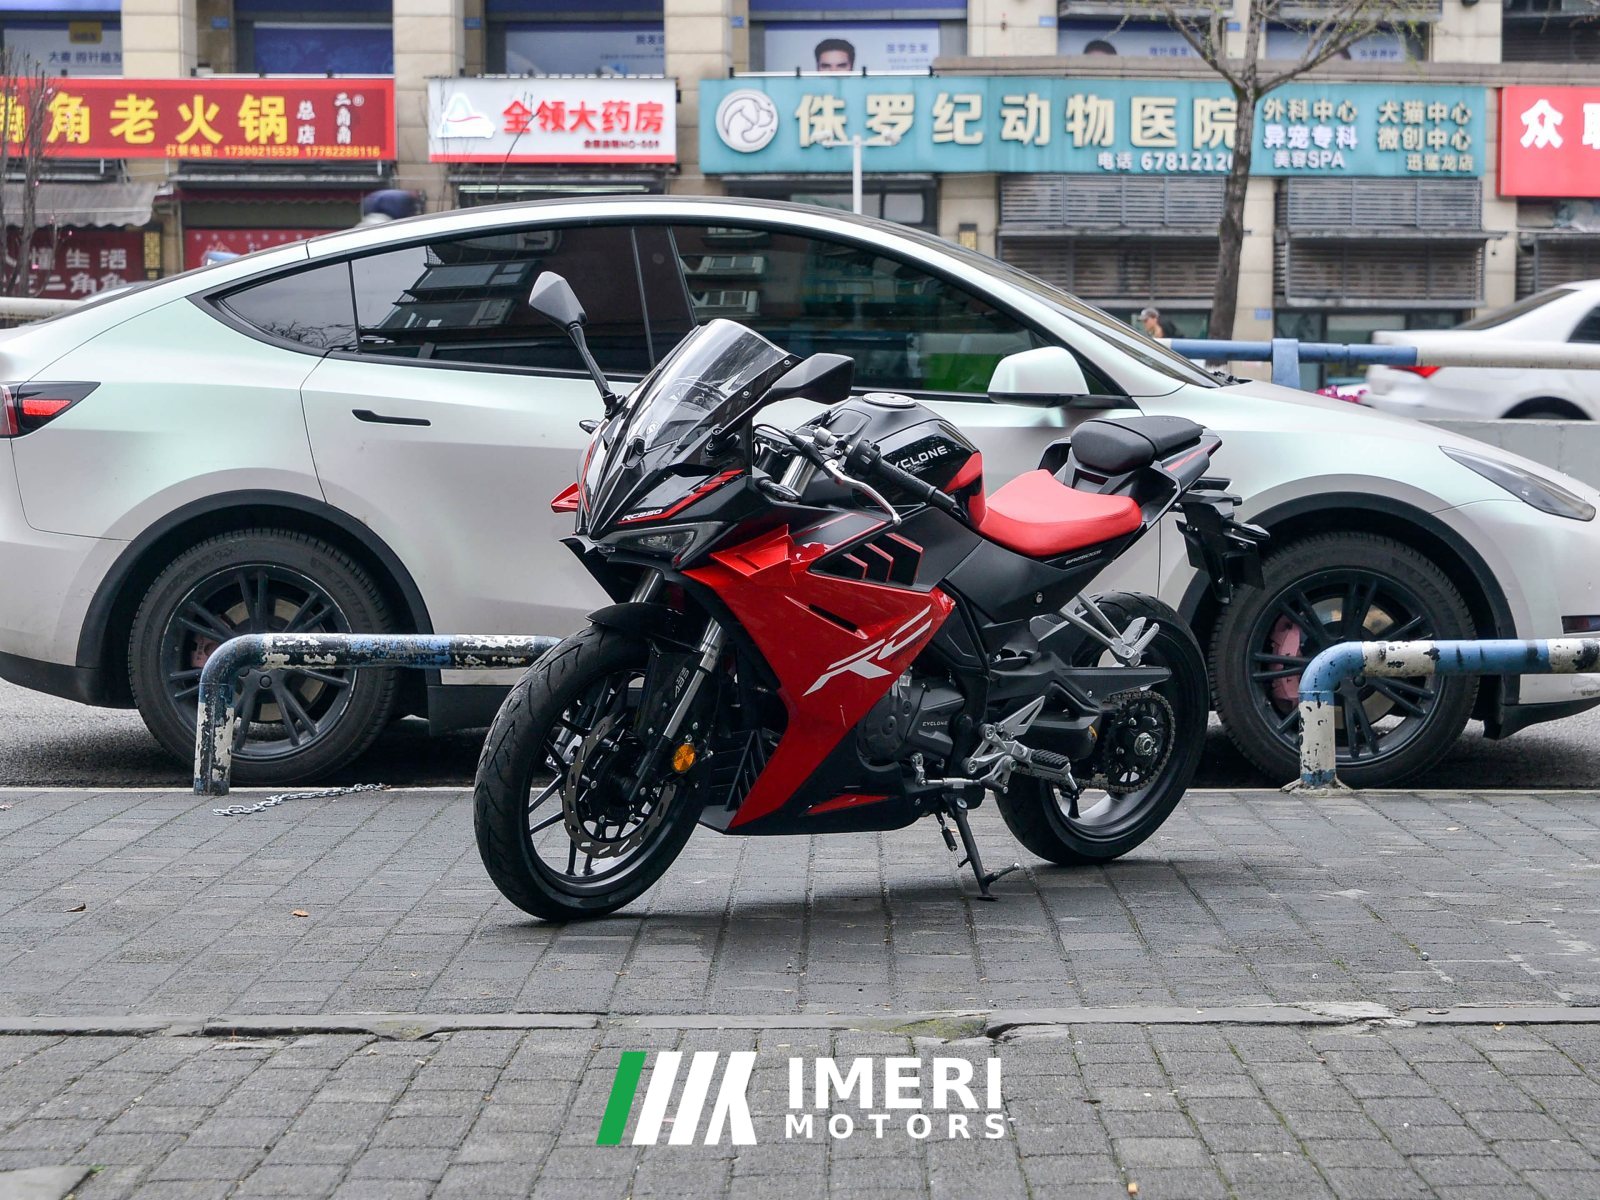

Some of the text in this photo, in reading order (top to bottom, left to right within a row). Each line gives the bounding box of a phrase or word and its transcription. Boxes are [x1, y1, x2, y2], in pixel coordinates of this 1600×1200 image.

[296, 100, 316, 144] 总店
[502, 100, 664, 134] 全领大药房
[795, 92, 1238, 151] 侏罗纪动物医院
[1263, 97, 1358, 123] 外科中心
[1377, 99, 1472, 125] 犬猫中心
[1263, 123, 1358, 150] 异宠专科
[1377, 126, 1472, 152] 微创中心
[1097, 151, 1133, 170] 电话
[1273, 150, 1345, 169] 美容SPA
[1406, 153, 1474, 172] 迅猛龙店
[621, 508, 664, 521] RC250
